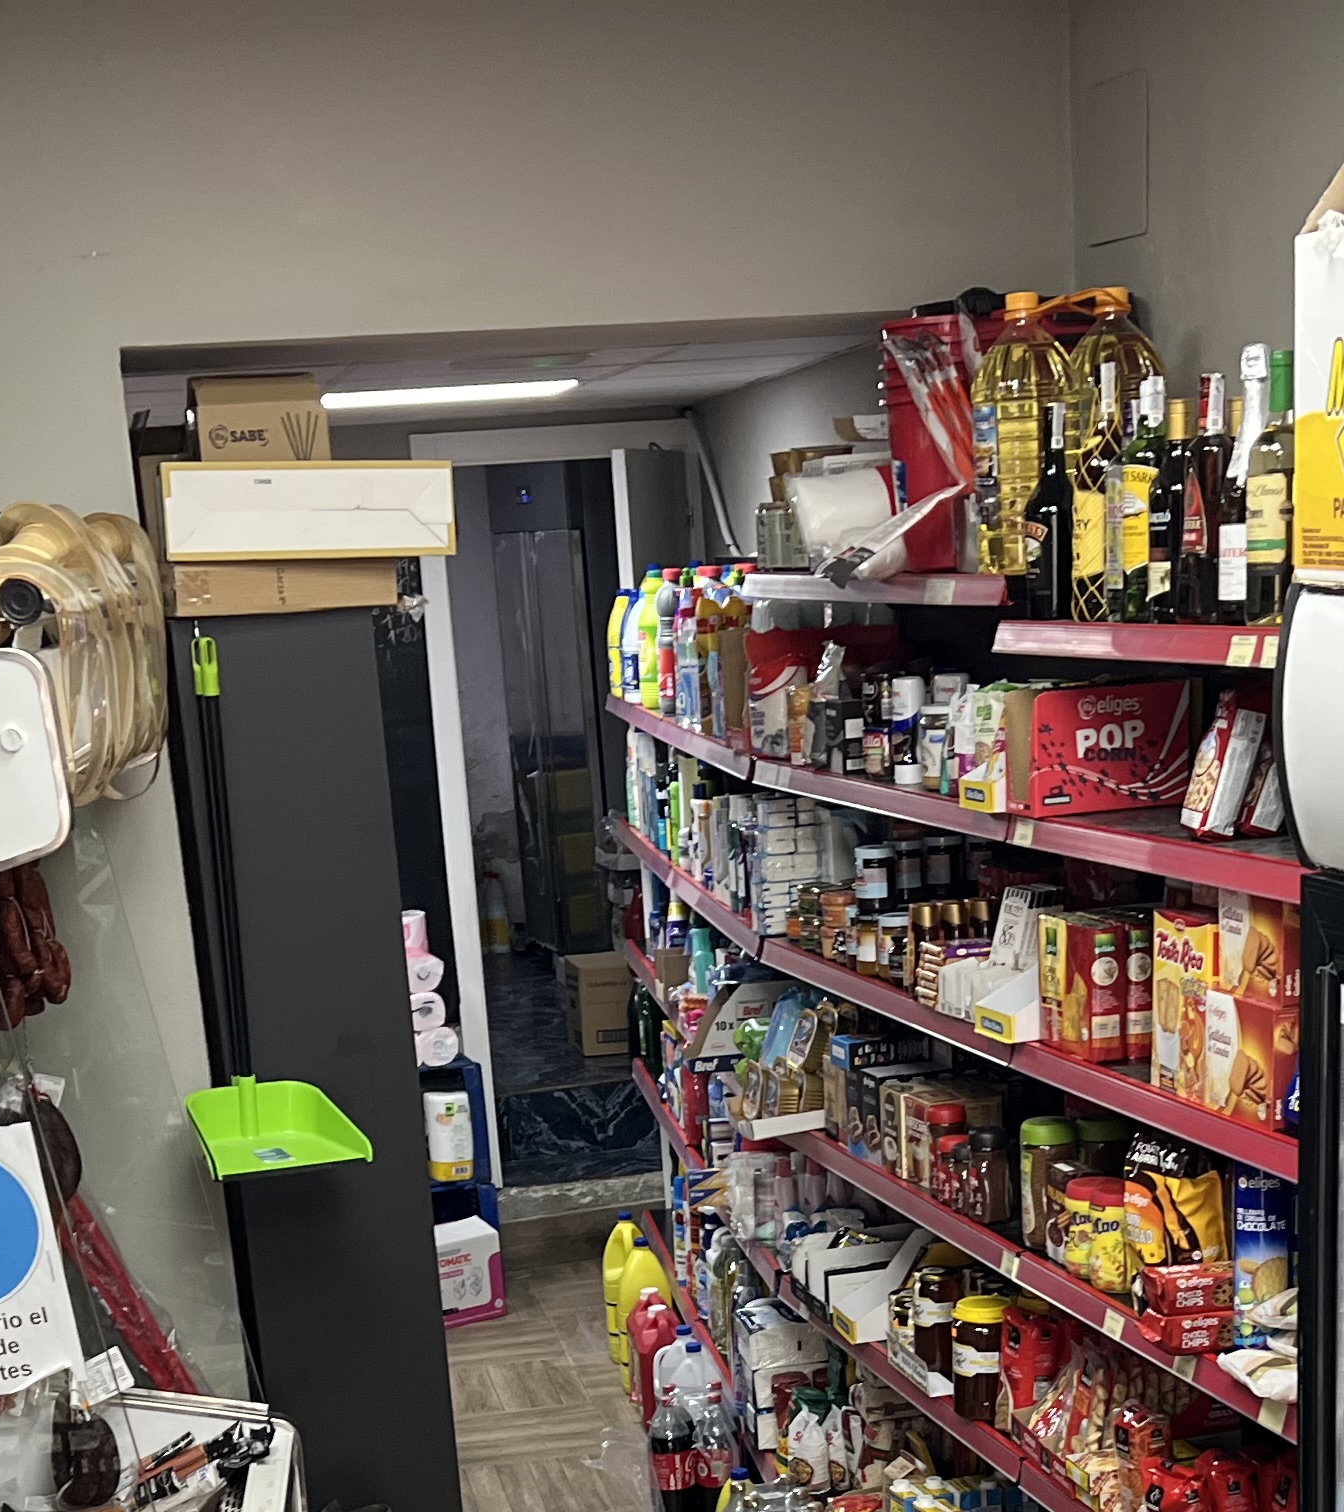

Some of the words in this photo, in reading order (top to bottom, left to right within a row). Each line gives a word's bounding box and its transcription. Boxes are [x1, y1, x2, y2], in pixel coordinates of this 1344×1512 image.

[1097, 695, 1141, 715] eliges
[1075, 719, 1146, 759] POP
[1084, 749, 1137, 763] CORN
[715, 1021, 727, 1032] 10
[694, 1059, 718, 1073] Bref
[29, 1306, 49, 1325] el
